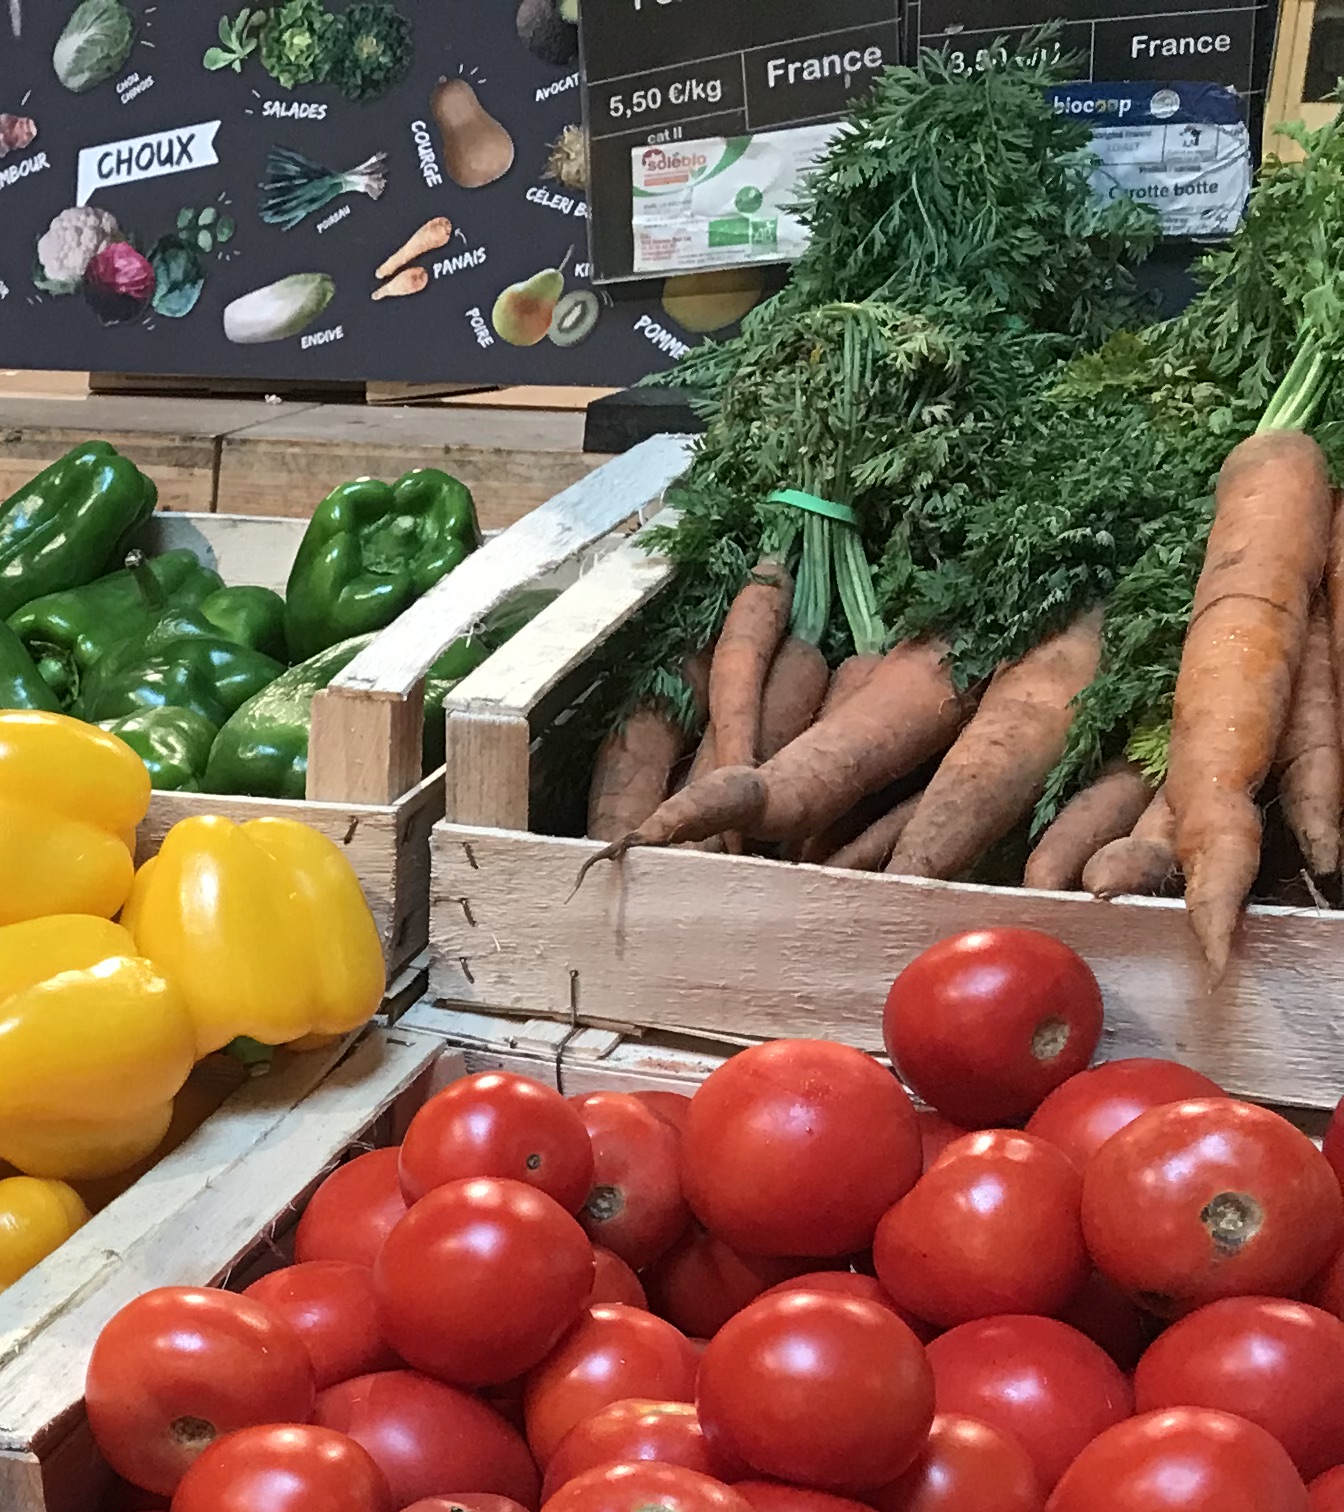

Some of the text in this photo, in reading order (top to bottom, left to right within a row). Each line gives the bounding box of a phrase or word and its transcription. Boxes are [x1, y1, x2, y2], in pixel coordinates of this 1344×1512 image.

[1132, 33, 1231, 59] France
[766, 46, 883, 88] France
[535, 73, 580, 102] AVOCAT
[609, 79, 722, 118] 5,50 €/kg
[262, 101, 327, 120] SALADES
[647, 129, 670, 145] cat
[97, 133, 196, 179] CHOUX
[411, 120, 443, 188] COURGE
[526, 186, 573, 215] CÉLERI
[1174, 180, 1219, 197] botte
[433, 247, 487, 279] PANAIS
[301, 325, 344, 349] ENDIVE
[465, 307, 494, 348] POIRE
